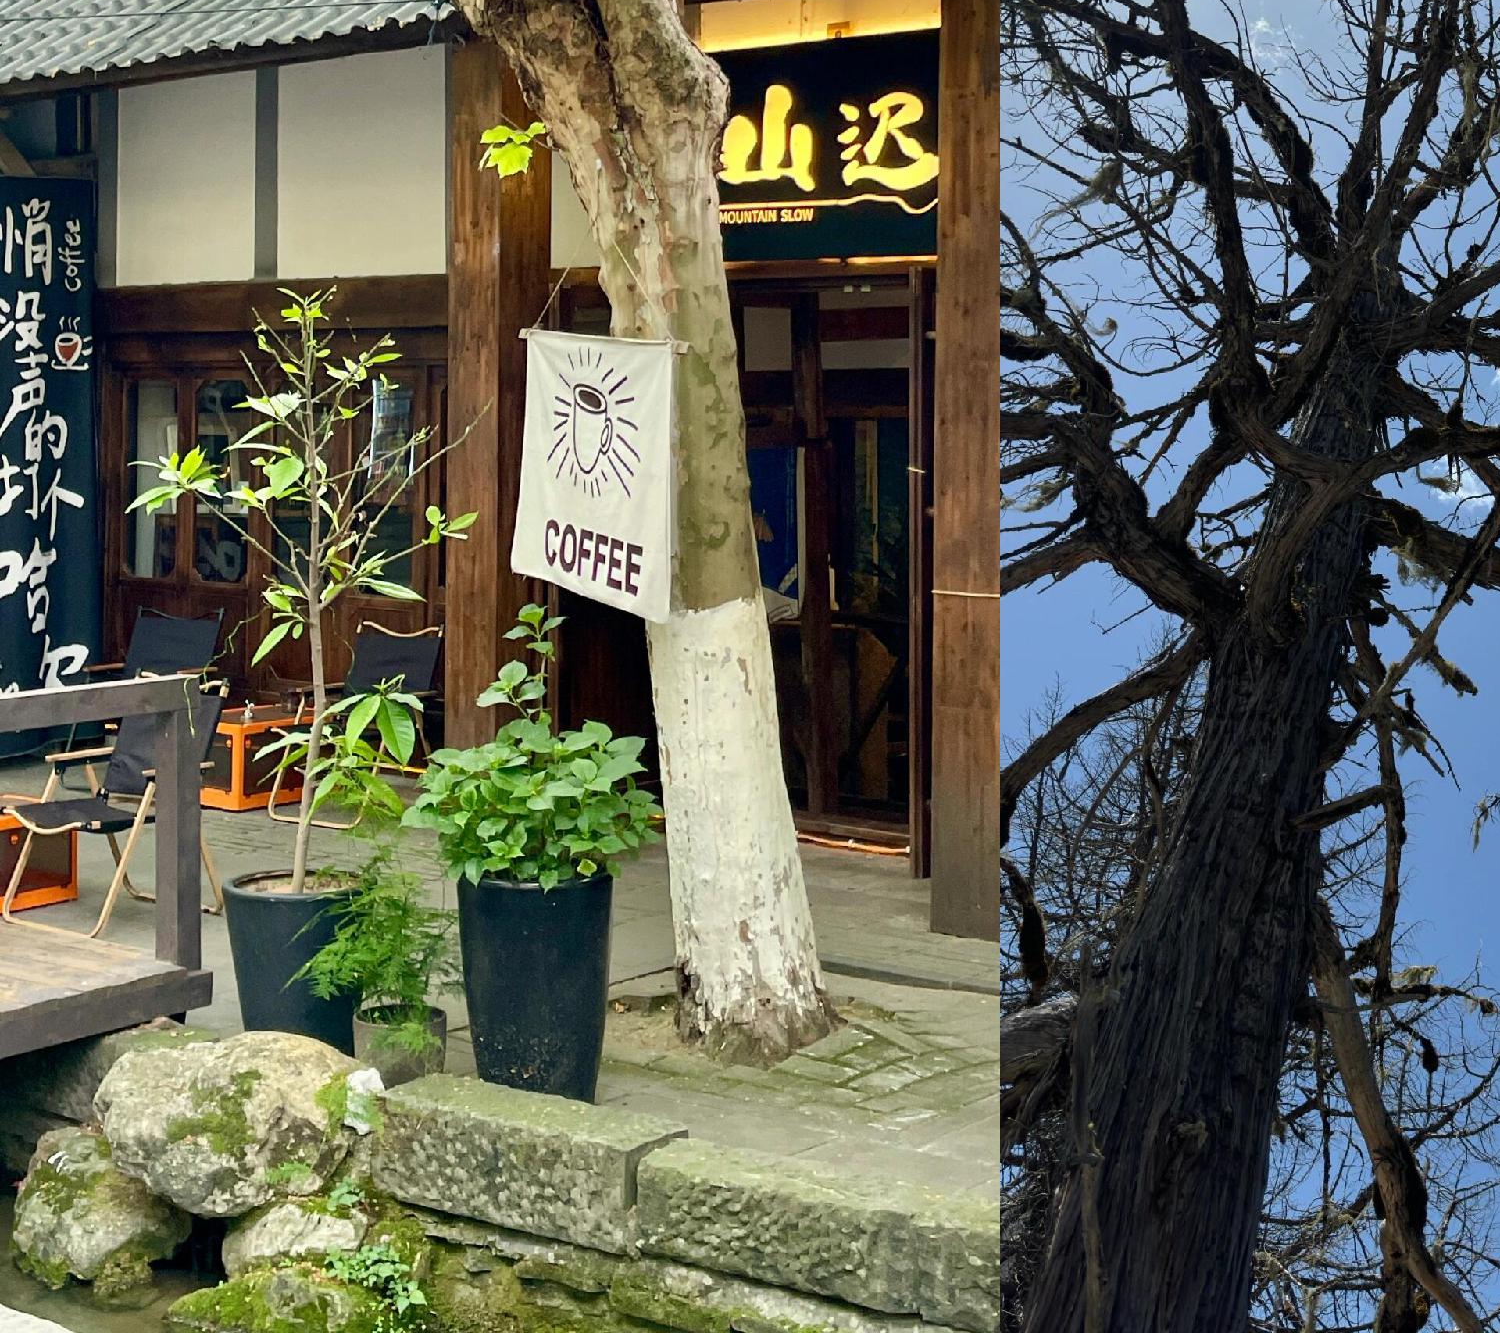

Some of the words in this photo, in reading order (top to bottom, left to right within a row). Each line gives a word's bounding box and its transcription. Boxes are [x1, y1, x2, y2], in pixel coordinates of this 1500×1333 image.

[720, 209, 778, 224] MOUNTAIN
[780, 208, 814, 222] SLOW
[544, 519, 644, 597] COFFEE
